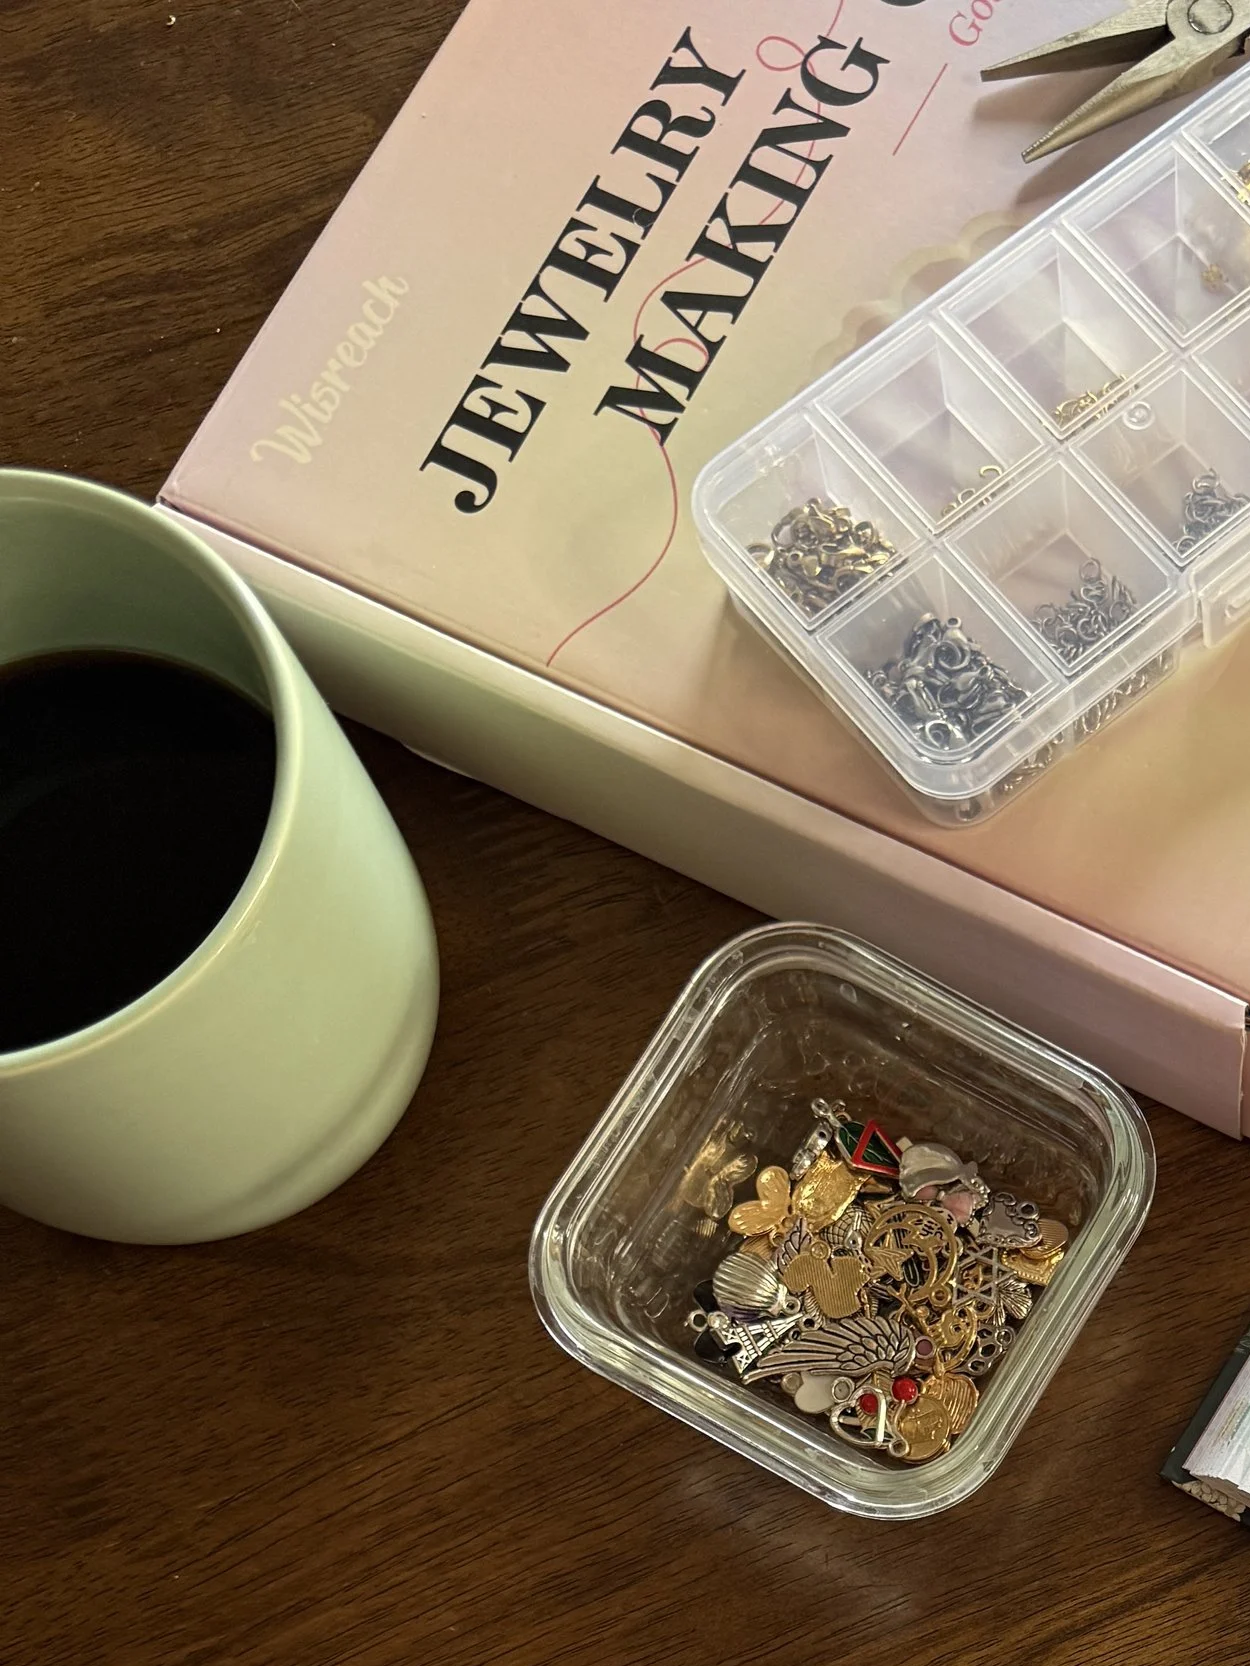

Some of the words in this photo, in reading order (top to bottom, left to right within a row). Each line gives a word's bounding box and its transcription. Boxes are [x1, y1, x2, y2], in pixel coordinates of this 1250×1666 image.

[250, 276, 410, 464] Wisreach
[419, 26, 746, 514] JEWELRY
[593, 34, 891, 446] MAKING
